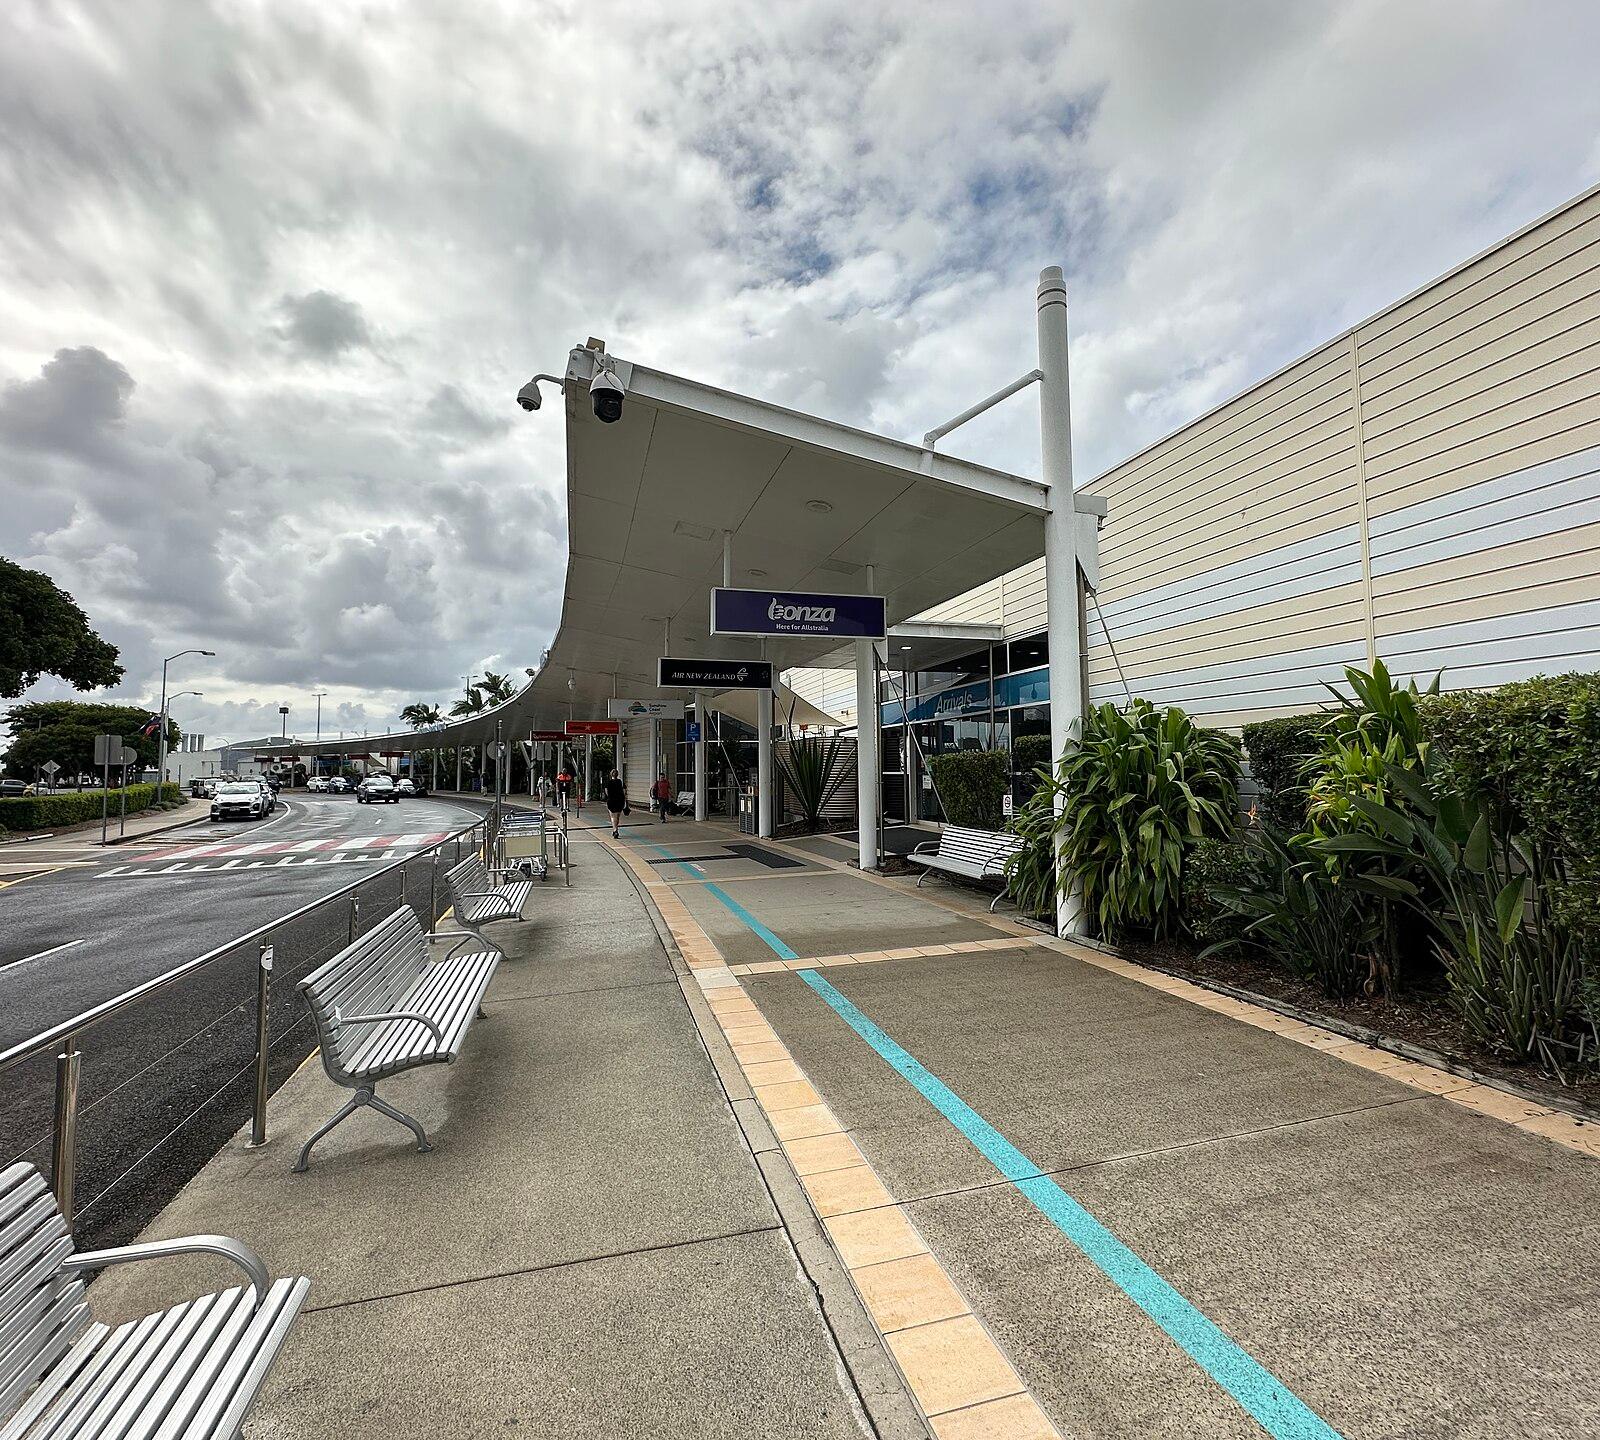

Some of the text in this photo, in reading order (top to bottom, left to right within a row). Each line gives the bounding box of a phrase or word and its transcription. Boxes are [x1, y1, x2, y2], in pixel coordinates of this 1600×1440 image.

[768, 597, 835, 621] bonza
[686, 672, 702, 680] NEW
[936, 690, 973, 712] Arrivals
